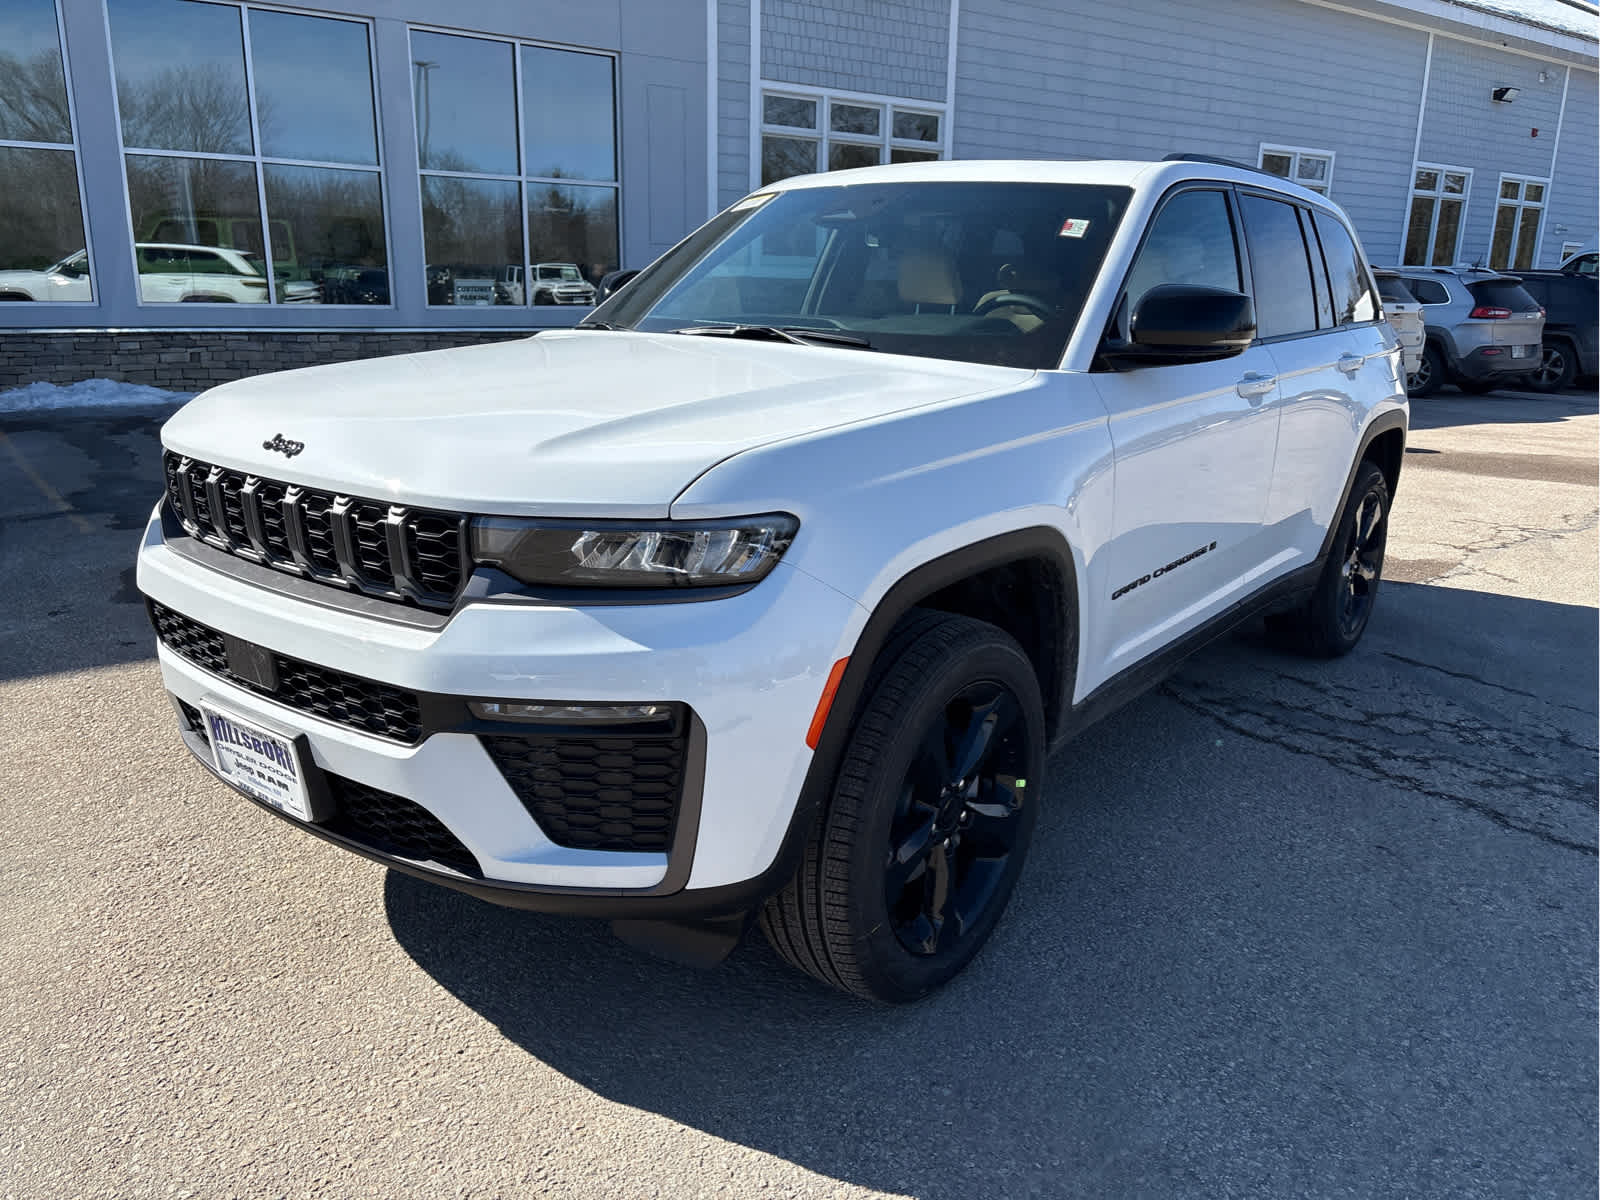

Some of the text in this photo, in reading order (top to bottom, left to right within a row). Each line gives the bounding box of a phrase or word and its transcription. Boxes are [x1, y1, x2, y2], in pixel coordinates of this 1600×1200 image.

[262, 433, 305, 459] Jeep
[1111, 545, 1209, 601] GRAND CHEROKEE
[216, 742, 298, 785] CHRYSLER DODGE
[234, 757, 255, 776] Jeep
[256, 769, 290, 793] RAM
